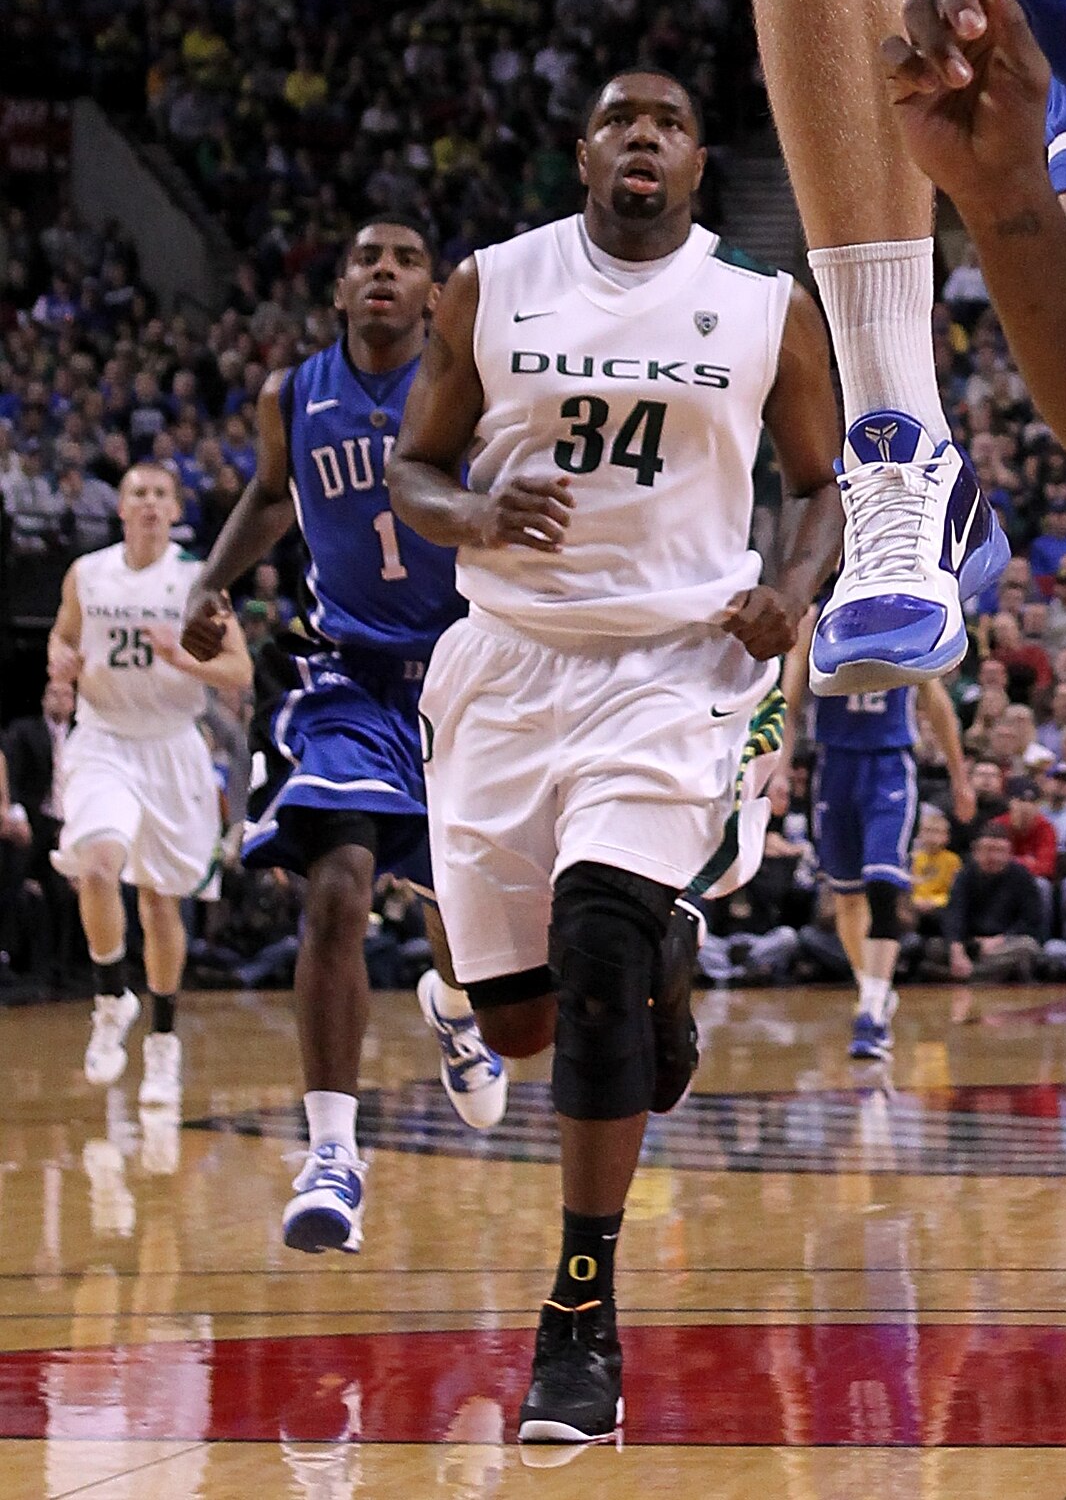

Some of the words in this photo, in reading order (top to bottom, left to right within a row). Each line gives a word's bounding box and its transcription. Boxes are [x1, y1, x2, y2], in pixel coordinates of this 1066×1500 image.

[511, 351, 731, 389] DUCKS
[553, 394, 668, 487] 34
[373, 510, 408, 581] 1
[108, 627, 154, 669] 25
